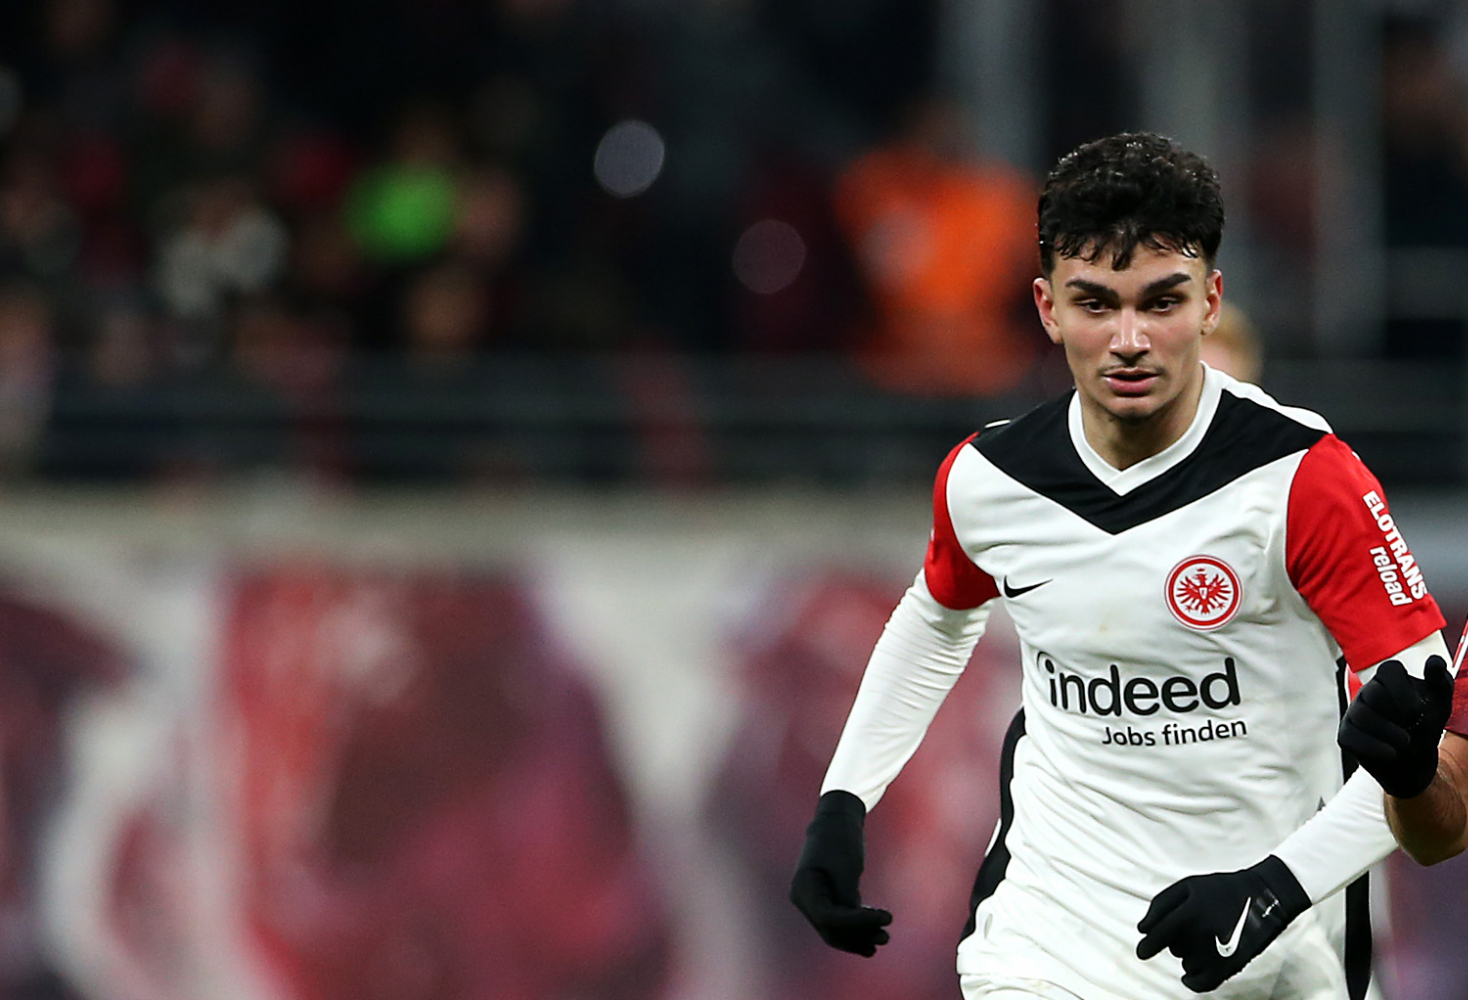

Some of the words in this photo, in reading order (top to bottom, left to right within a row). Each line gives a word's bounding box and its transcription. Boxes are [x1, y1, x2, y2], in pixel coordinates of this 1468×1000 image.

[1362, 490, 1429, 600] ELOTRANS
[1369, 546, 1413, 606] reload
[1037, 650, 1241, 717] indeed
[1102, 726, 1156, 746] Jobs
[1162, 719, 1247, 746] finden
